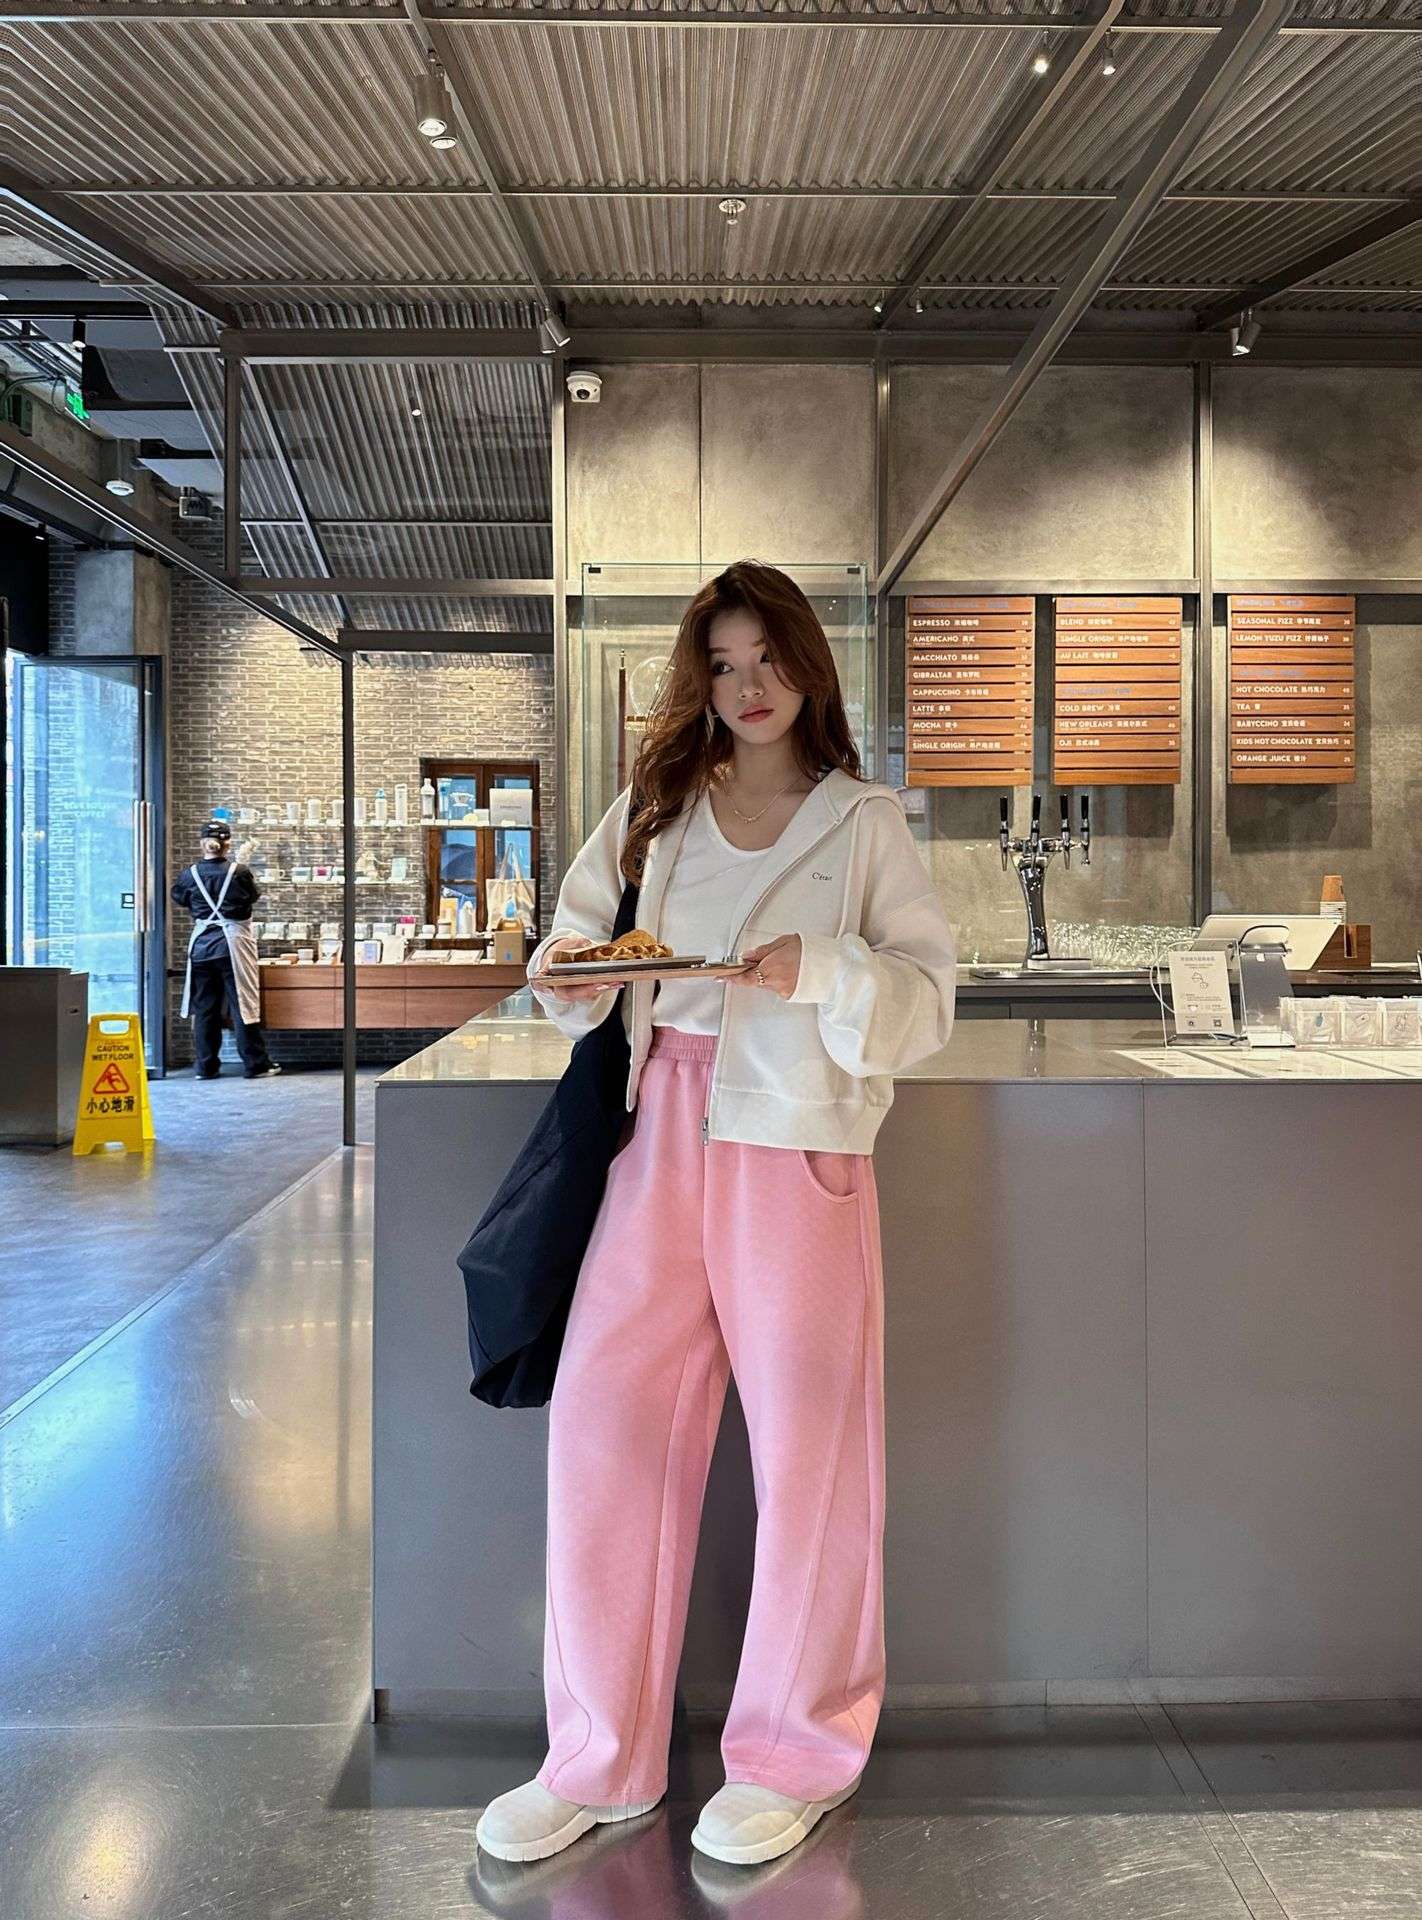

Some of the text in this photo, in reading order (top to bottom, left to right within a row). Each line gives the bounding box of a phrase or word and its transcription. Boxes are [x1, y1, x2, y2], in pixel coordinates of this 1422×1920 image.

[912, 619, 951, 627] ESPRESSO
[1060, 618, 1084, 626] BLEND
[912, 635, 959, 643] AMERICANO
[1060, 635, 1115, 643] SINGLE ORIGIN
[912, 671, 952, 679] GIBRALTAR
[912, 721, 941, 729] MOCHA
[91, 1053, 134, 1061] WET FLOOR
[87, 1096, 134, 1114] 小心地滑
